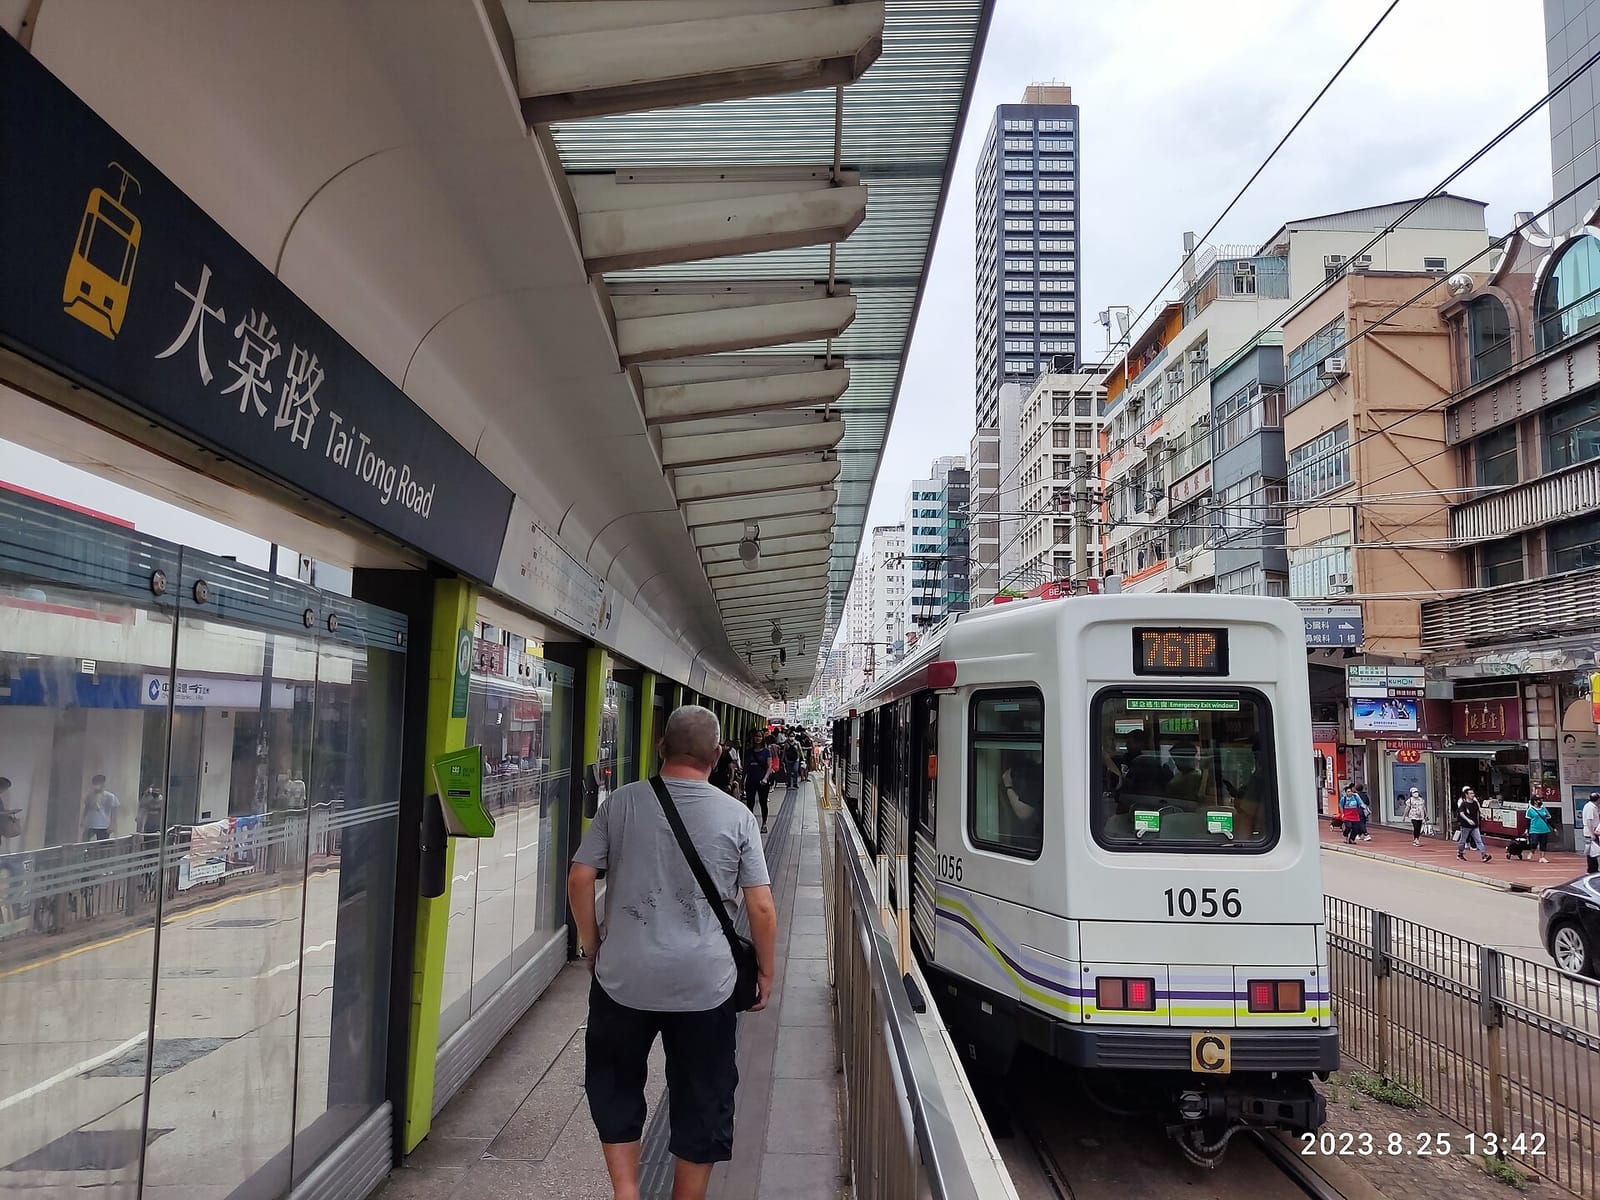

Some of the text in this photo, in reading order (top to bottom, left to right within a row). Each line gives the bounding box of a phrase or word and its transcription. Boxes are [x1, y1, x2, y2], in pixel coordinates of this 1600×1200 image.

[155, 263, 325, 451] 大棠路
[325, 410, 437, 520] Tai Tong Road
[1142, 631, 1217, 669] 761P
[1388, 678, 1413, 686] KUMON
[1169, 701, 1200, 709] Emergency
[937, 853, 963, 882] 1056
[1164, 887, 1242, 919] 1056
[1195, 1035, 1225, 1071] C
